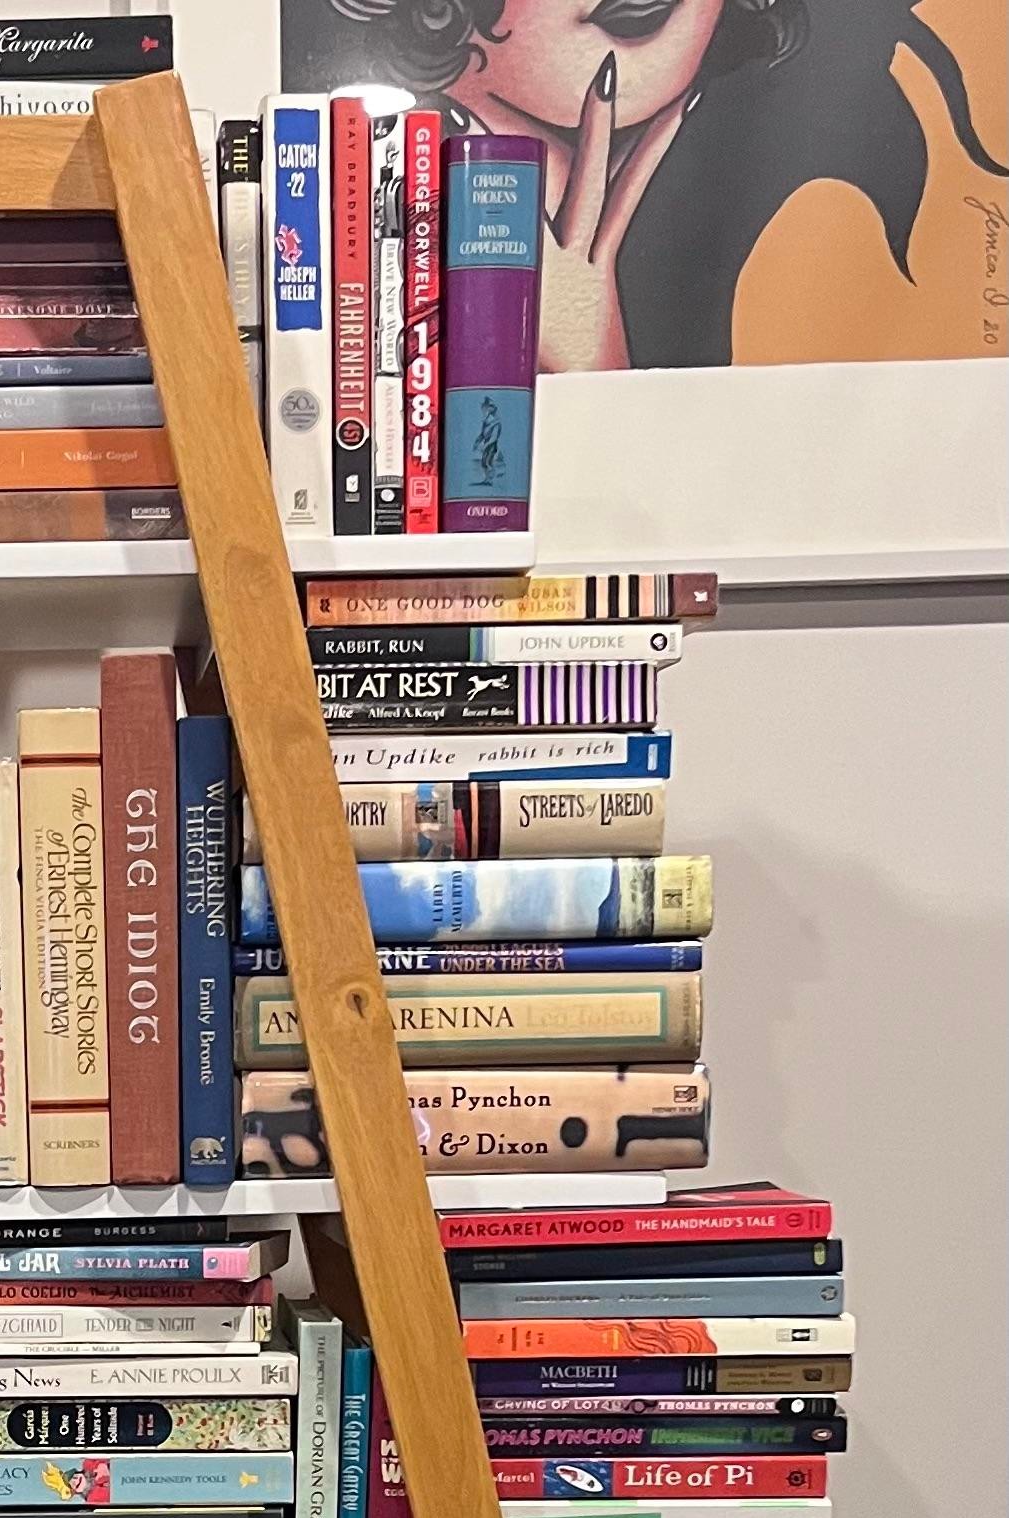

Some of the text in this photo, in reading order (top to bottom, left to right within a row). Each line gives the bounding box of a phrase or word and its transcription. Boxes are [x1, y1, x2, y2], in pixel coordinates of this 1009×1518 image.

[278, 144, 316, 169] CATCH
[414, 128, 430, 306] GEORGE ORWELL
[277, 267, 316, 283] JOSEPH
[280, 283, 315, 300] HELLER
[339, 282, 365, 413] FAHRENHEIT
[411, 322, 431, 462] 1984
[325, 638, 424, 654] RABBIT, RUN
[478, 741, 615, 762] rabbit is rich
[519, 792, 653, 829] STREETS LAREDO
[185, 804, 206, 914] HEIGHTS
[206, 779, 226, 939] WUTHERING
[451, 1086, 552, 1112] Pynchon
[439, 1132, 548, 1156] & Dixon
[449, 1215, 775, 1238] MARGARET ATWOOD THE HANDMAID'S TALE
[18, 1252, 61, 1274] JAR
[75, 1257, 132, 1270] SYLVIA
[139, 1257, 189, 1269] PLATH
[624, 1465, 754, 1486] Life of Pi
